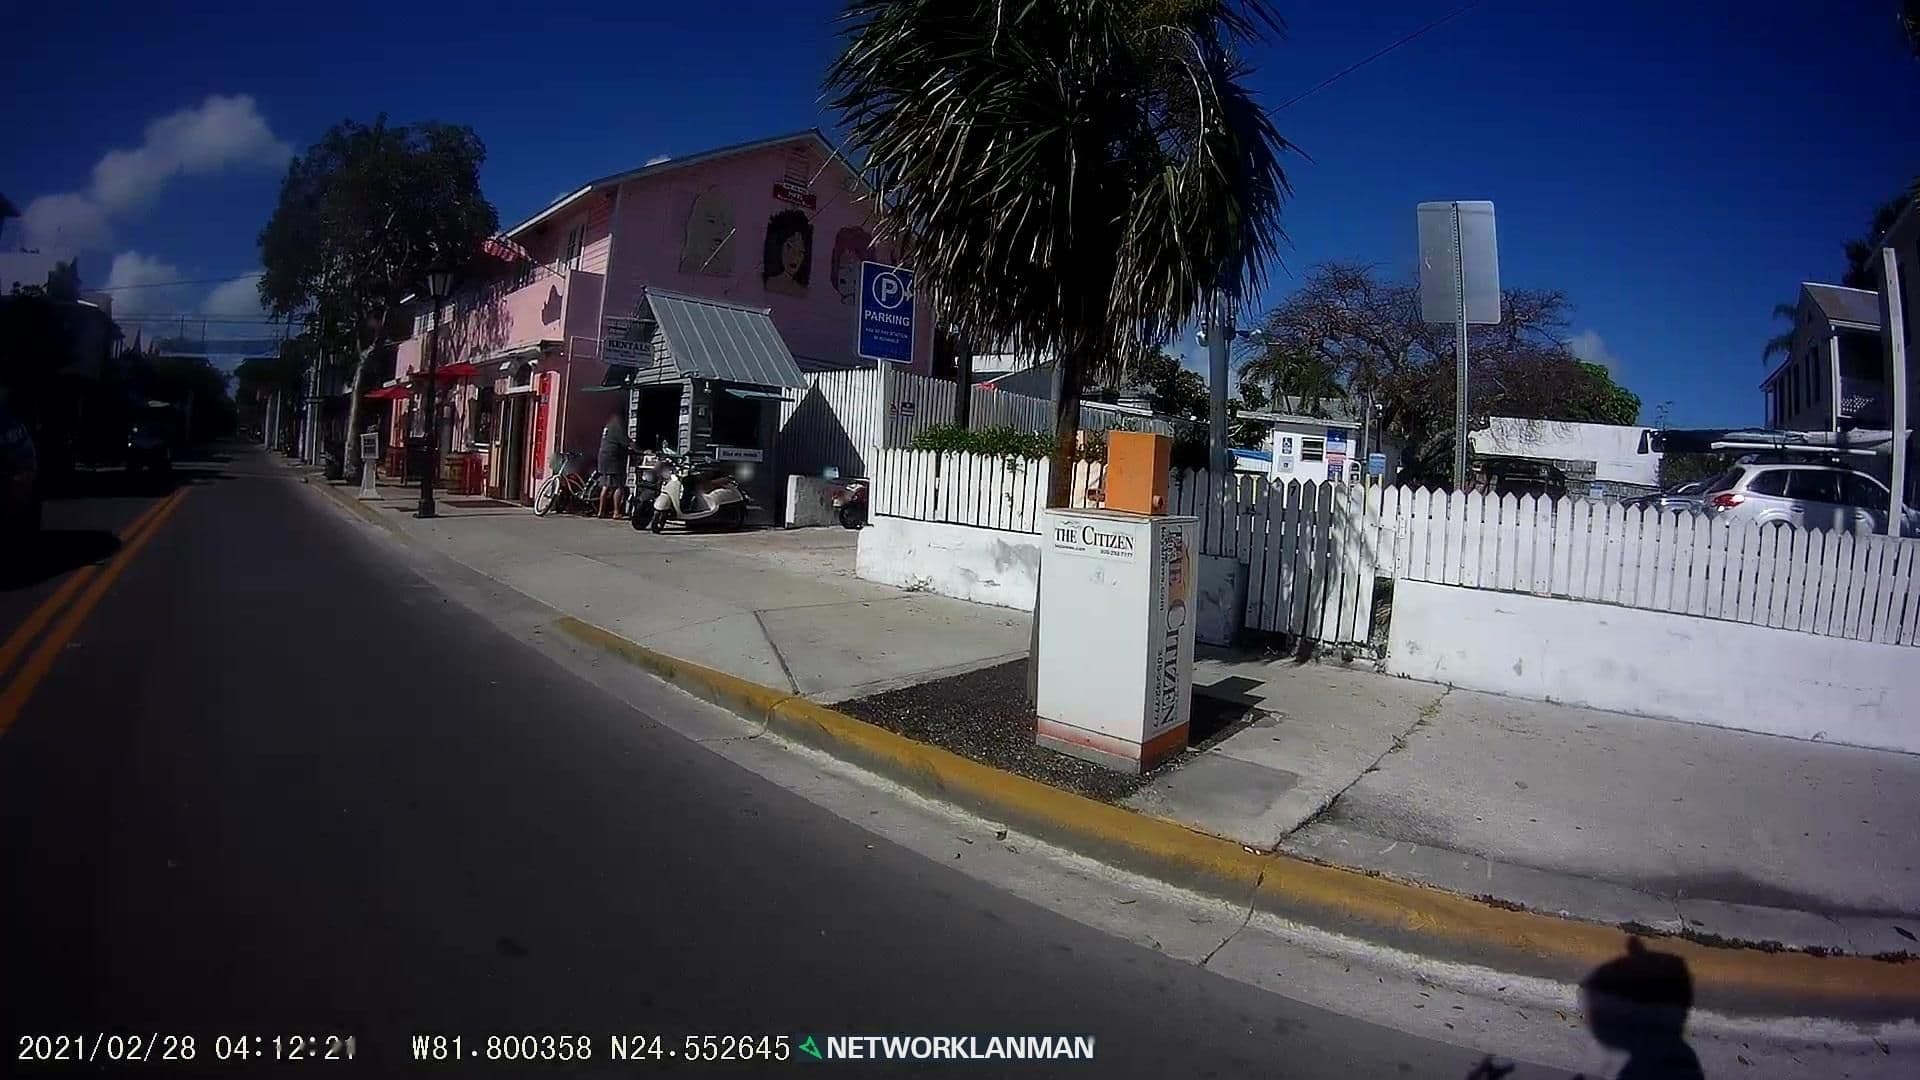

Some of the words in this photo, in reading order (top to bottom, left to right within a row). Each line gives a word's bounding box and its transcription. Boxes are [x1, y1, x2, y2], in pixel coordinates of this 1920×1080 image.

[882, 278, 898, 301] P
[865, 309, 910, 327] PARKING
[608, 339, 652, 353] RENTALS
[1055, 527, 1078, 543] THE
